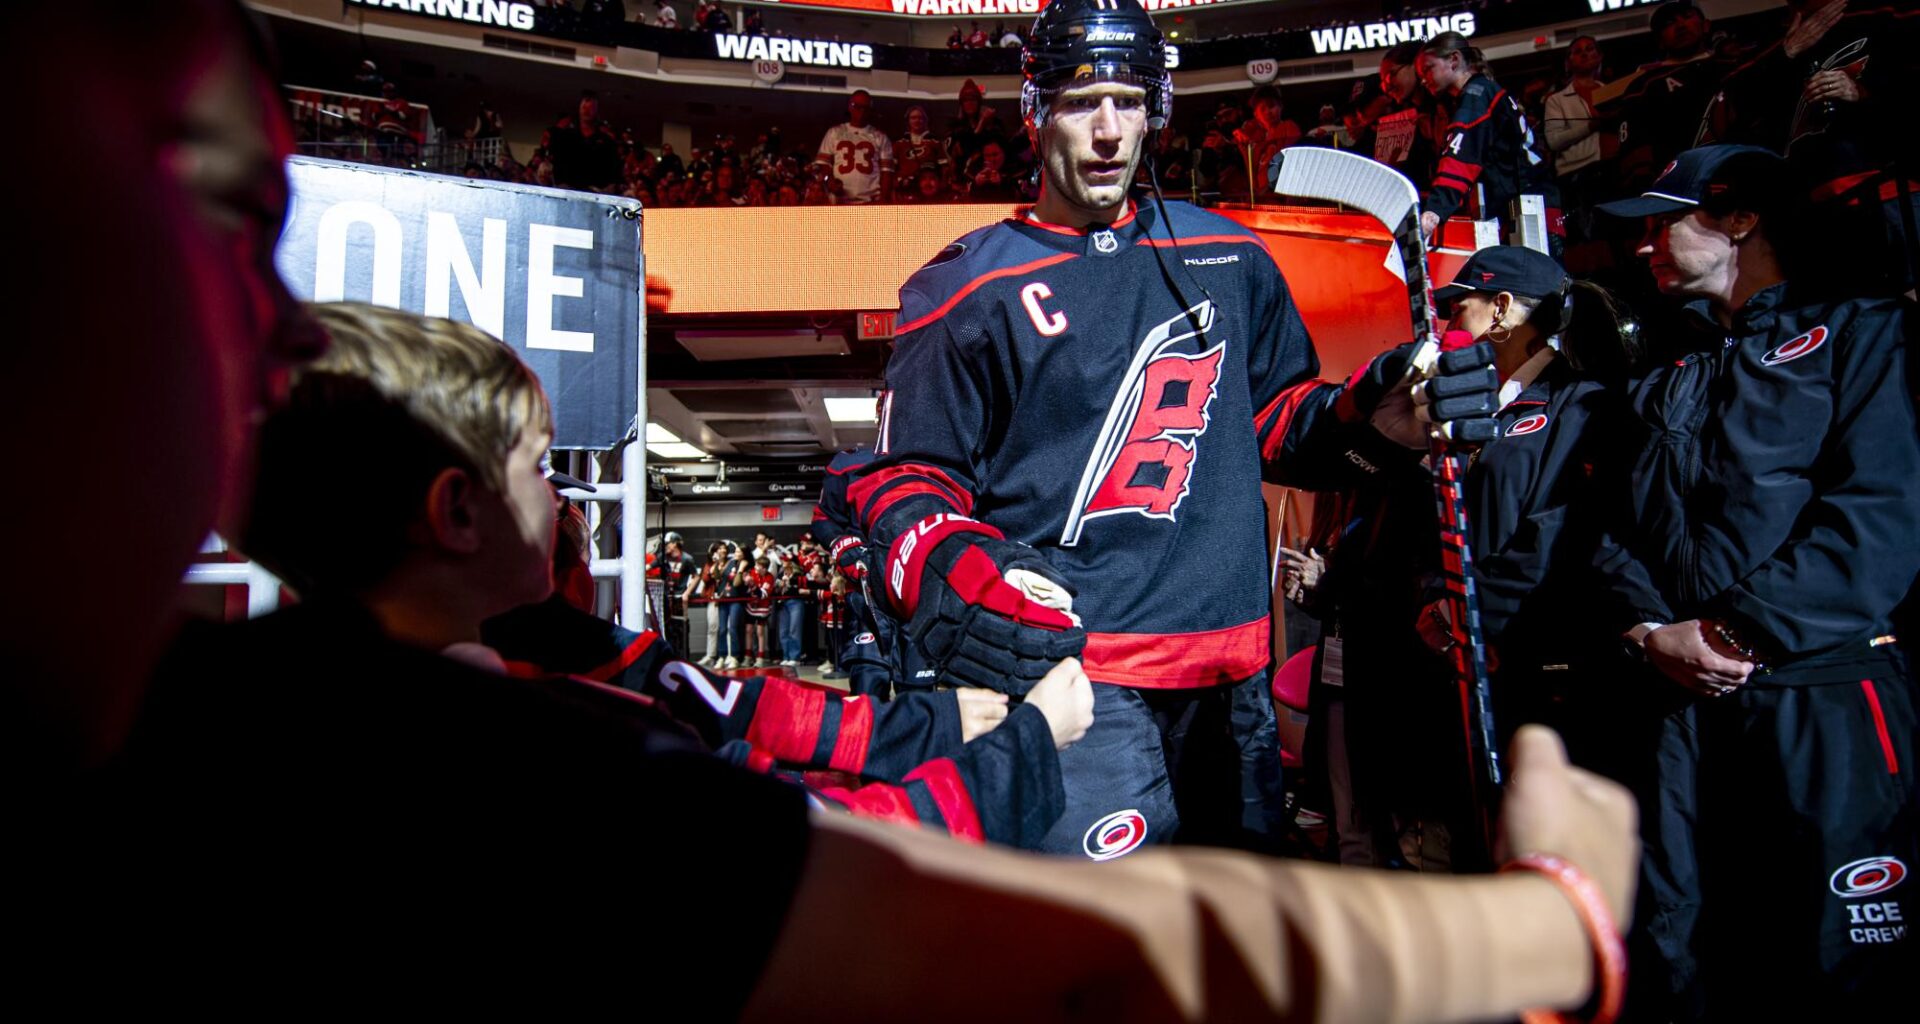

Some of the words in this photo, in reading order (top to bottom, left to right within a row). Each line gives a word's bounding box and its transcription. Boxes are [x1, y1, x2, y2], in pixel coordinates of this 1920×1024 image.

[1310, 12, 1476, 54] WARNING
[715, 34, 873, 68] WARNING
[757, 62, 780, 75] 108
[1251, 64, 1274, 75] 109
[836, 140, 875, 175] 33
[313, 199, 595, 353] ONE
[1184, 255, 1239, 266] NUCOR
[863, 312, 895, 337] EXIT
[1018, 281, 1069, 337] C
[658, 660, 743, 716] 2
[1846, 902, 1904, 924] ICE
